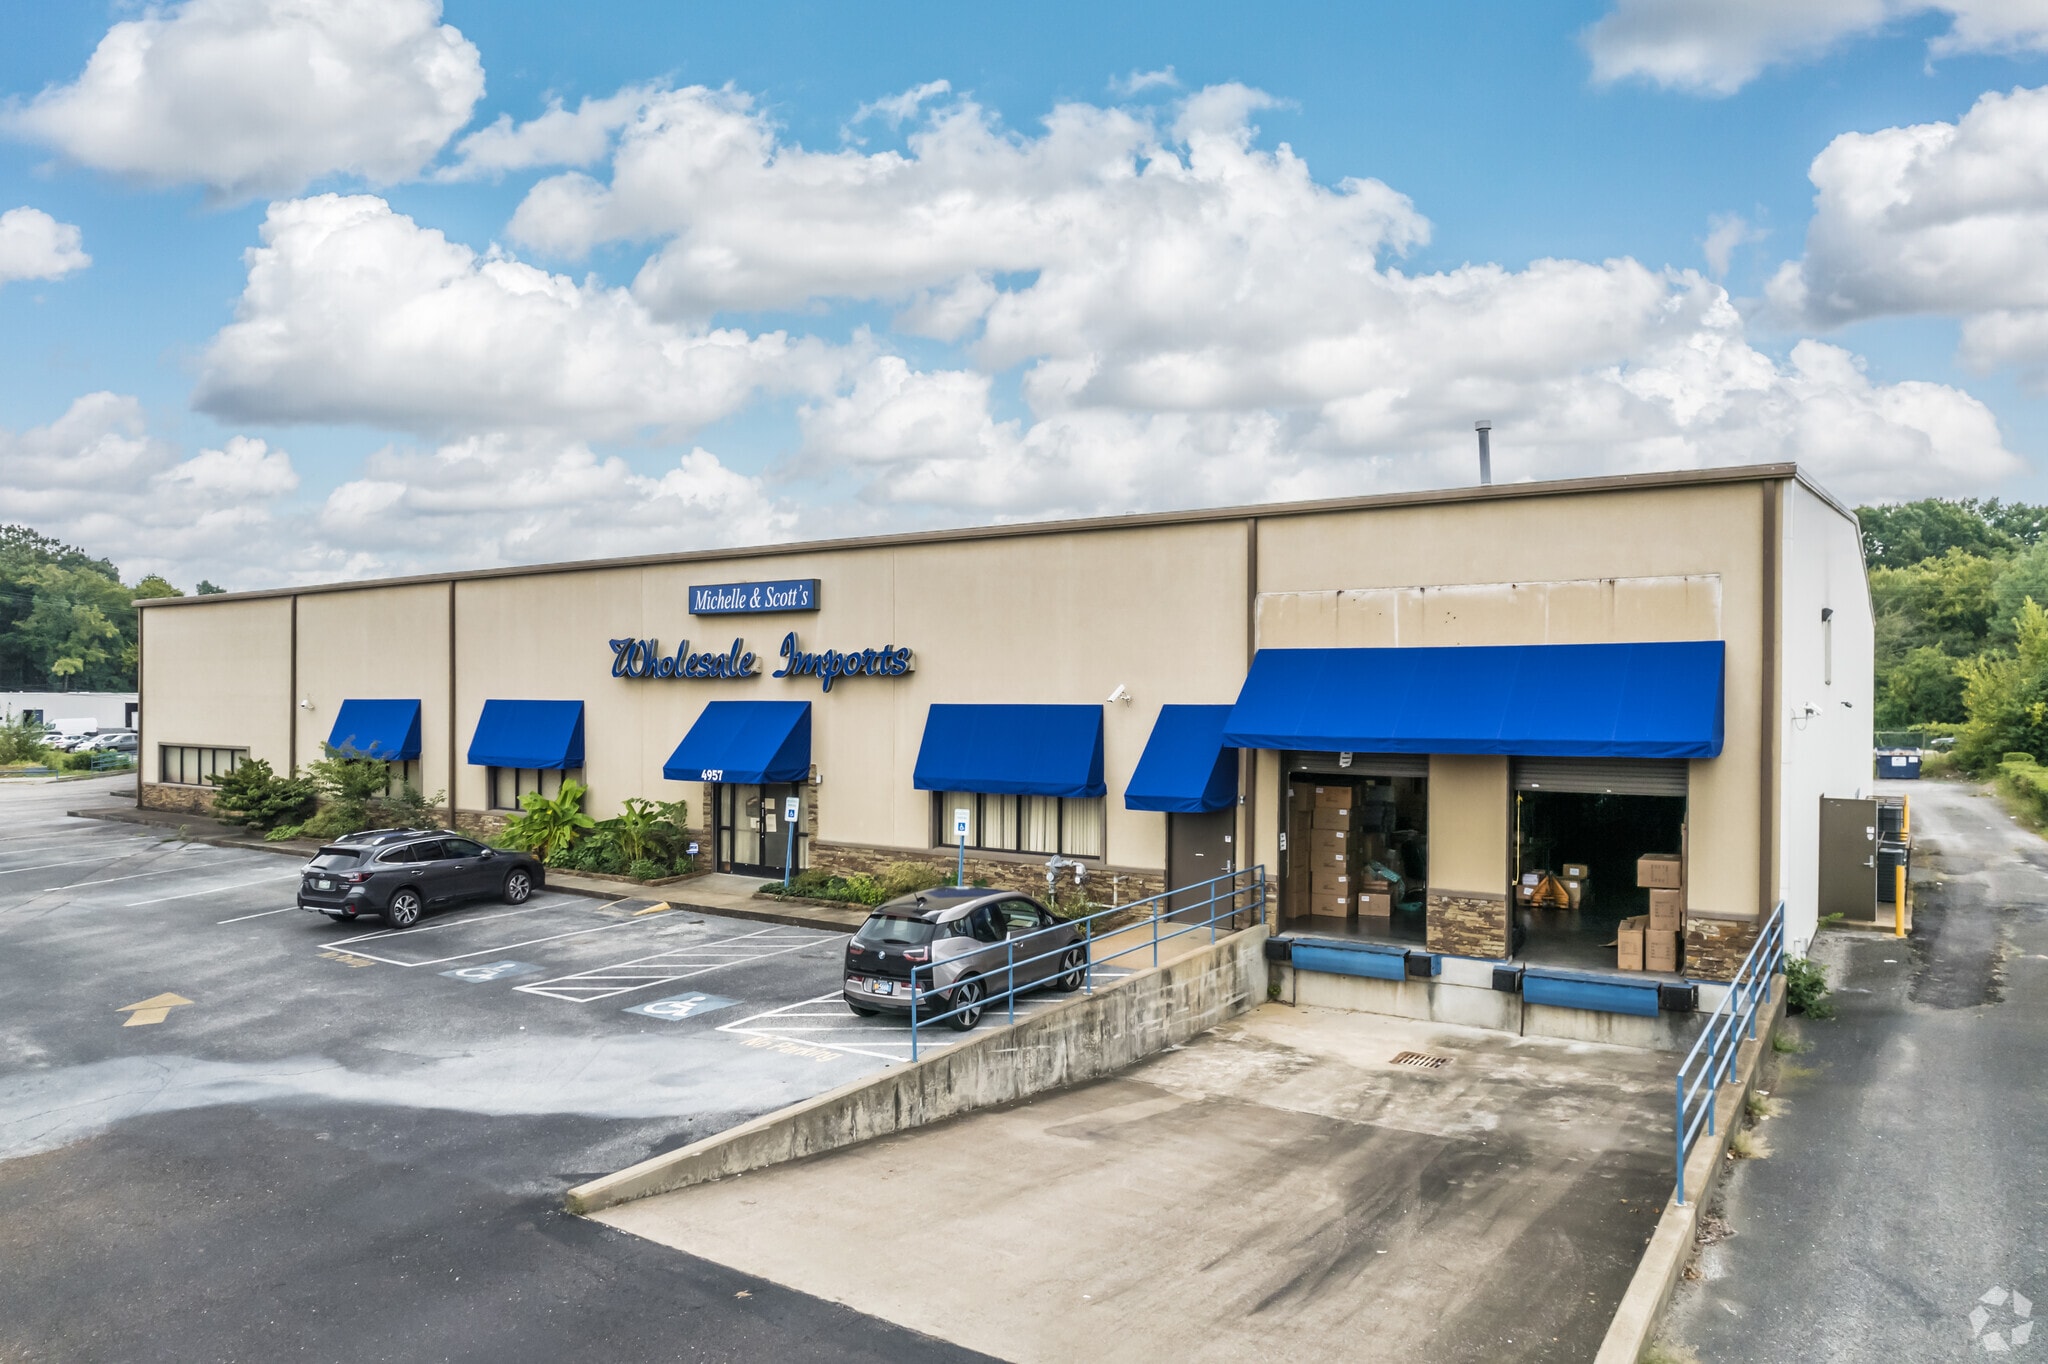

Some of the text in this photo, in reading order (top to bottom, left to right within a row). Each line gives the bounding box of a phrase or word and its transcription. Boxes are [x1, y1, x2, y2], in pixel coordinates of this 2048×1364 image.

[694, 584, 809, 610] Michelle & Scott's
[609, 631, 913, 693] Wholesale Imports
[701, 769, 723, 781] 4957
